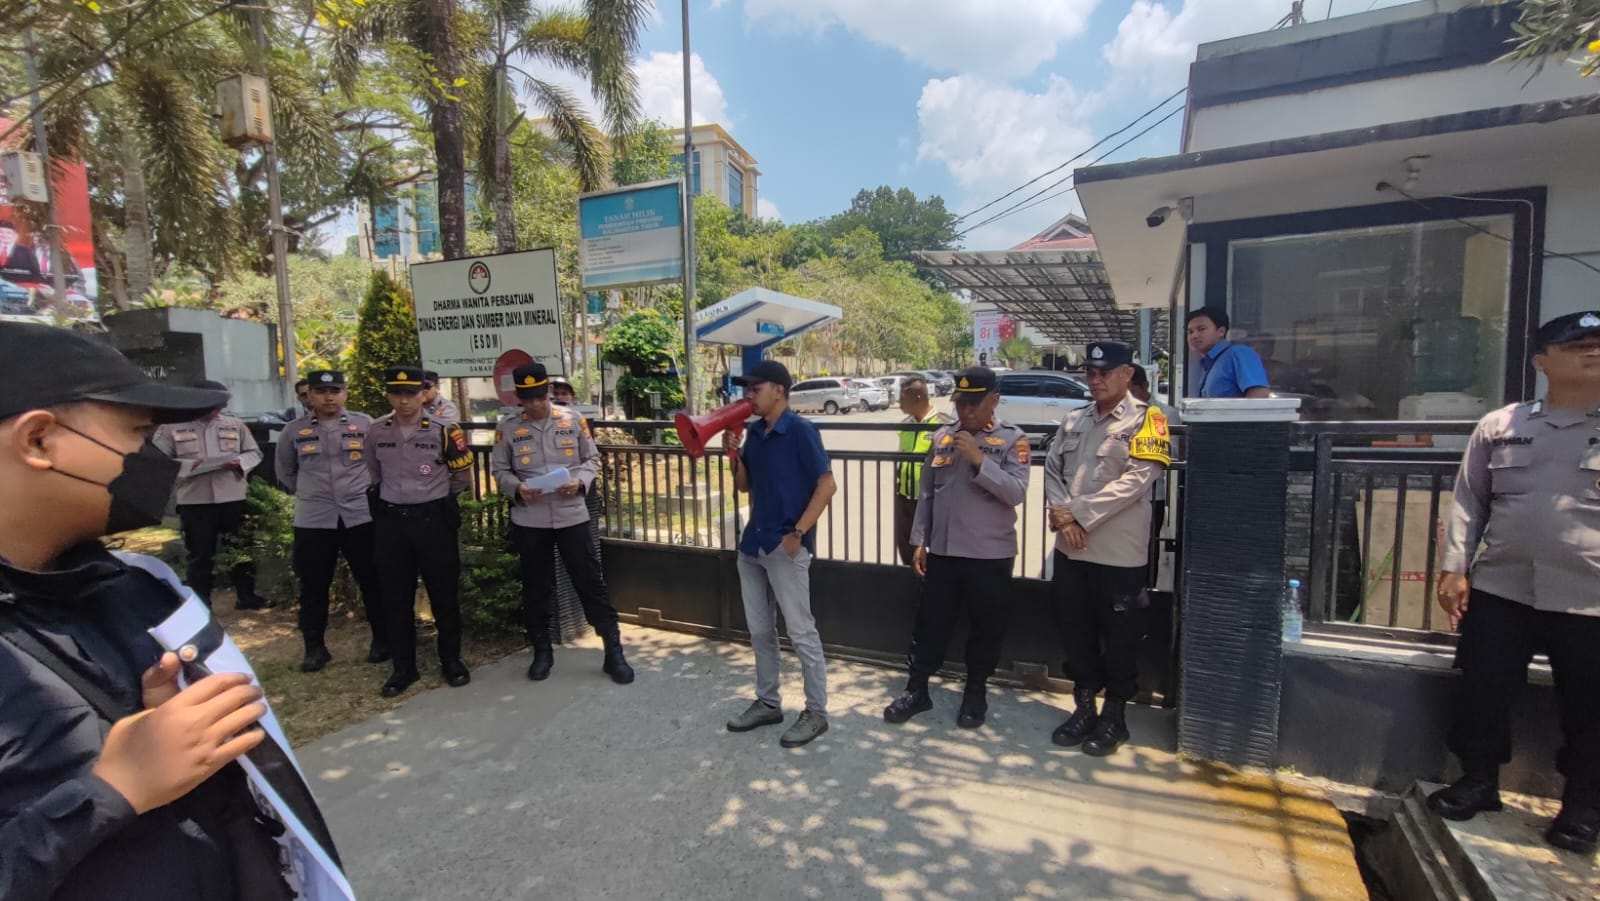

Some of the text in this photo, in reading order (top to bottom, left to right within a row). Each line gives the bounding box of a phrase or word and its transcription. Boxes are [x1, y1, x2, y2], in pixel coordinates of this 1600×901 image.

[433, 292, 534, 311] DHARMA WANITA PERSATUAN
[418, 308, 556, 332] DINAS ENERGI DAN SUMBER DAYA MINERAL
